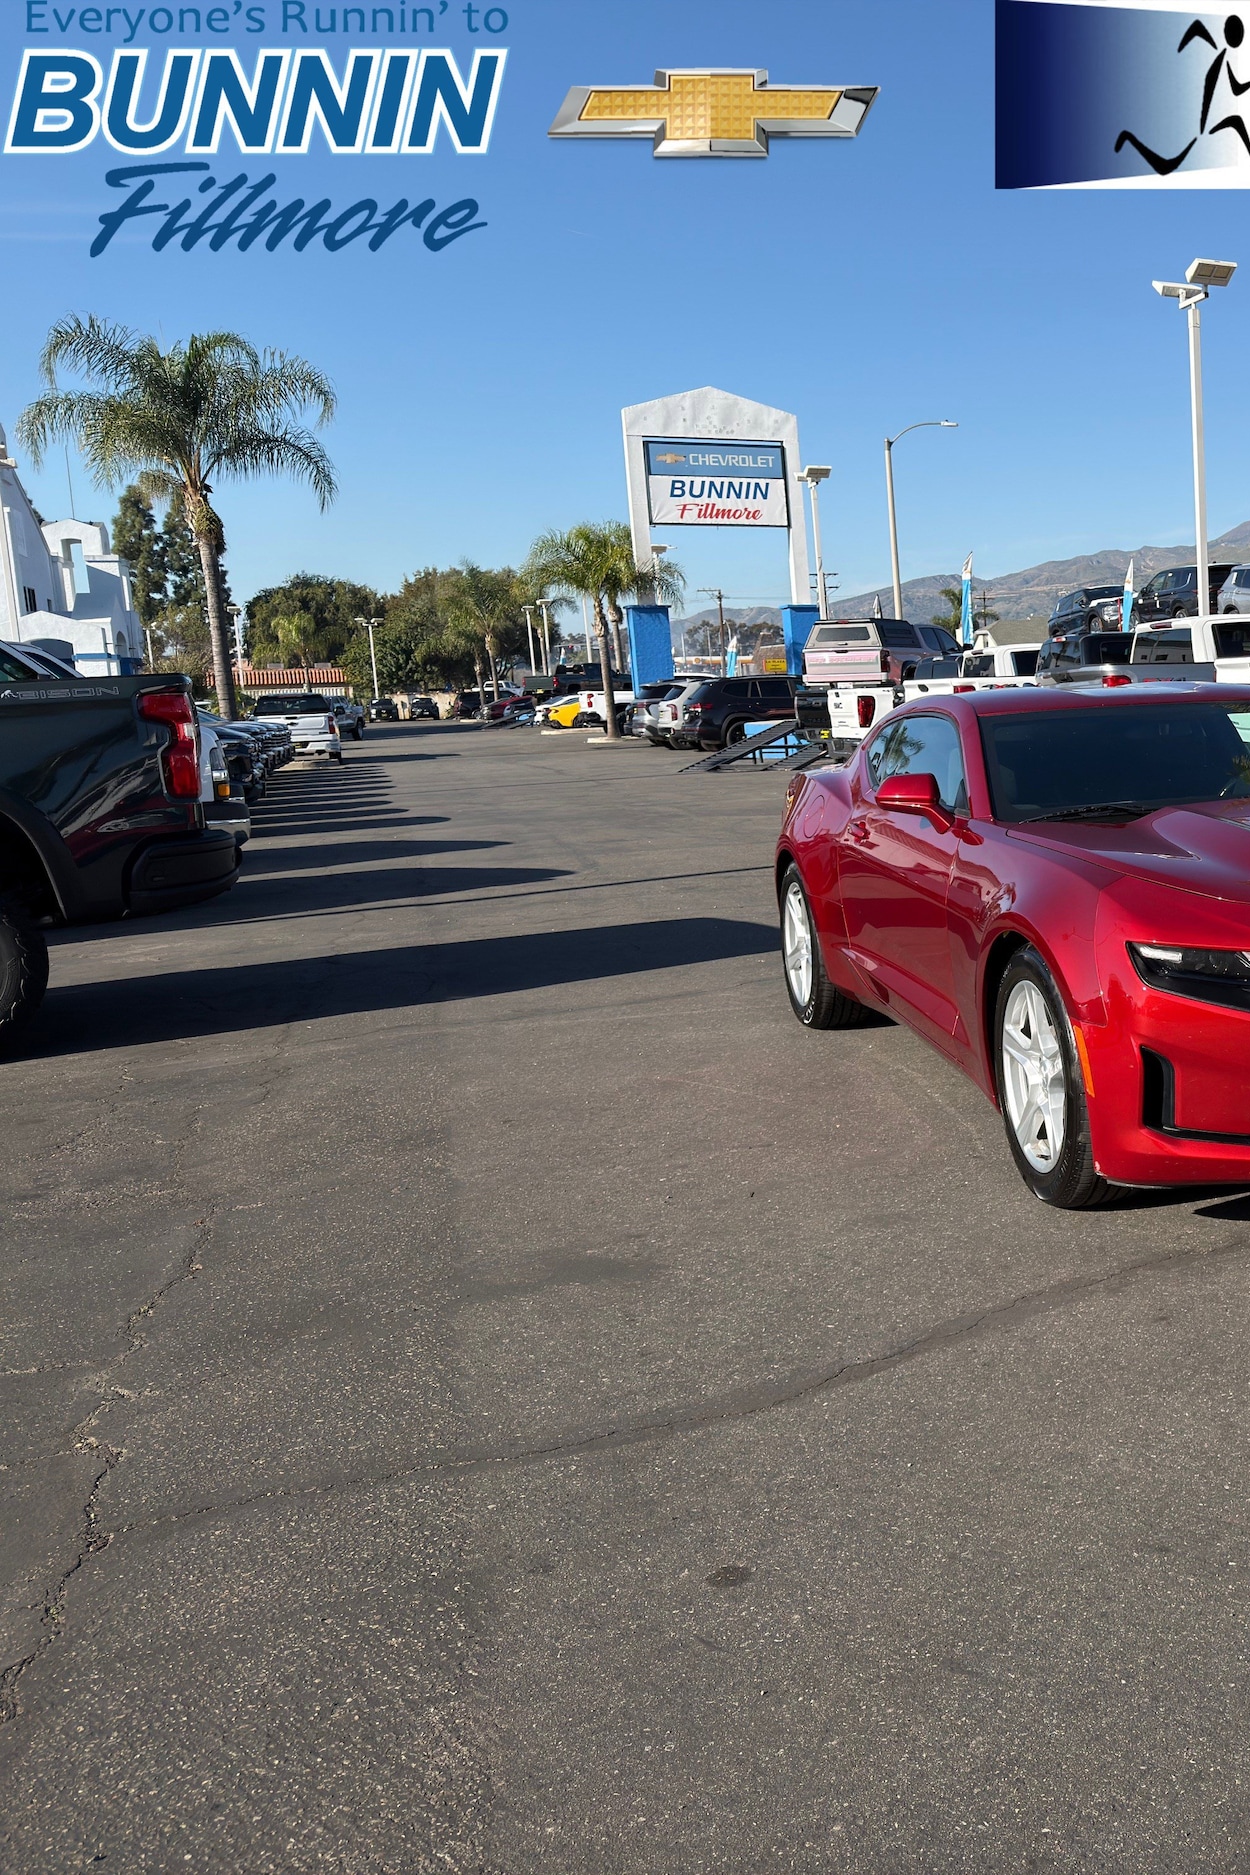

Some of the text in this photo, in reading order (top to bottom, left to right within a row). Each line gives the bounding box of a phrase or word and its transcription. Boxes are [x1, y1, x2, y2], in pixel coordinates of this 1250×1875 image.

[689, 453, 775, 468] CHEVROLET
[669, 479, 770, 500] BUNNIN
[675, 502, 763, 520] Fillmore
[19, 686, 120, 700] BISON
